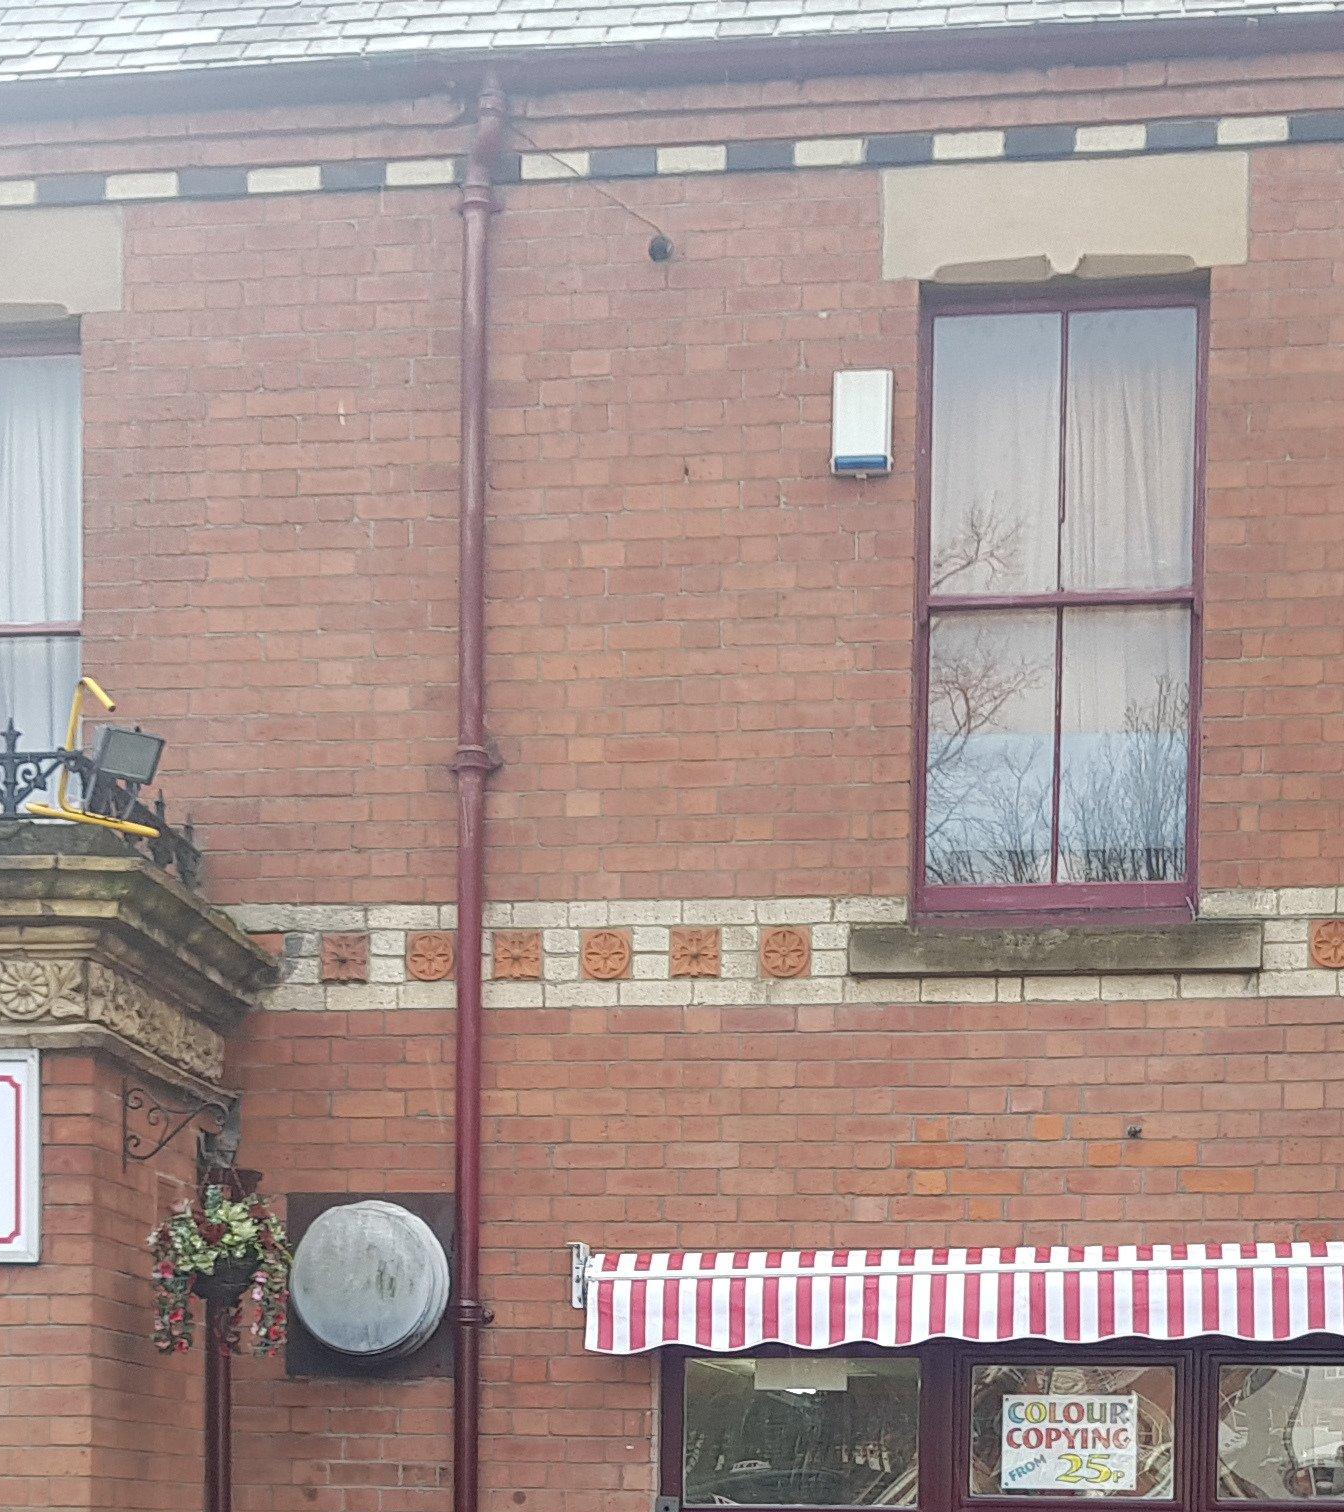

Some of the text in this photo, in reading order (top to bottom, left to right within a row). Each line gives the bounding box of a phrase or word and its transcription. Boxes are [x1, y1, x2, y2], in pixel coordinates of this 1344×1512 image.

[1008, 1402, 1129, 1424] COLOUR
[1006, 1427, 1131, 1450] COPYING
[1007, 1453, 1047, 1483] FROM
